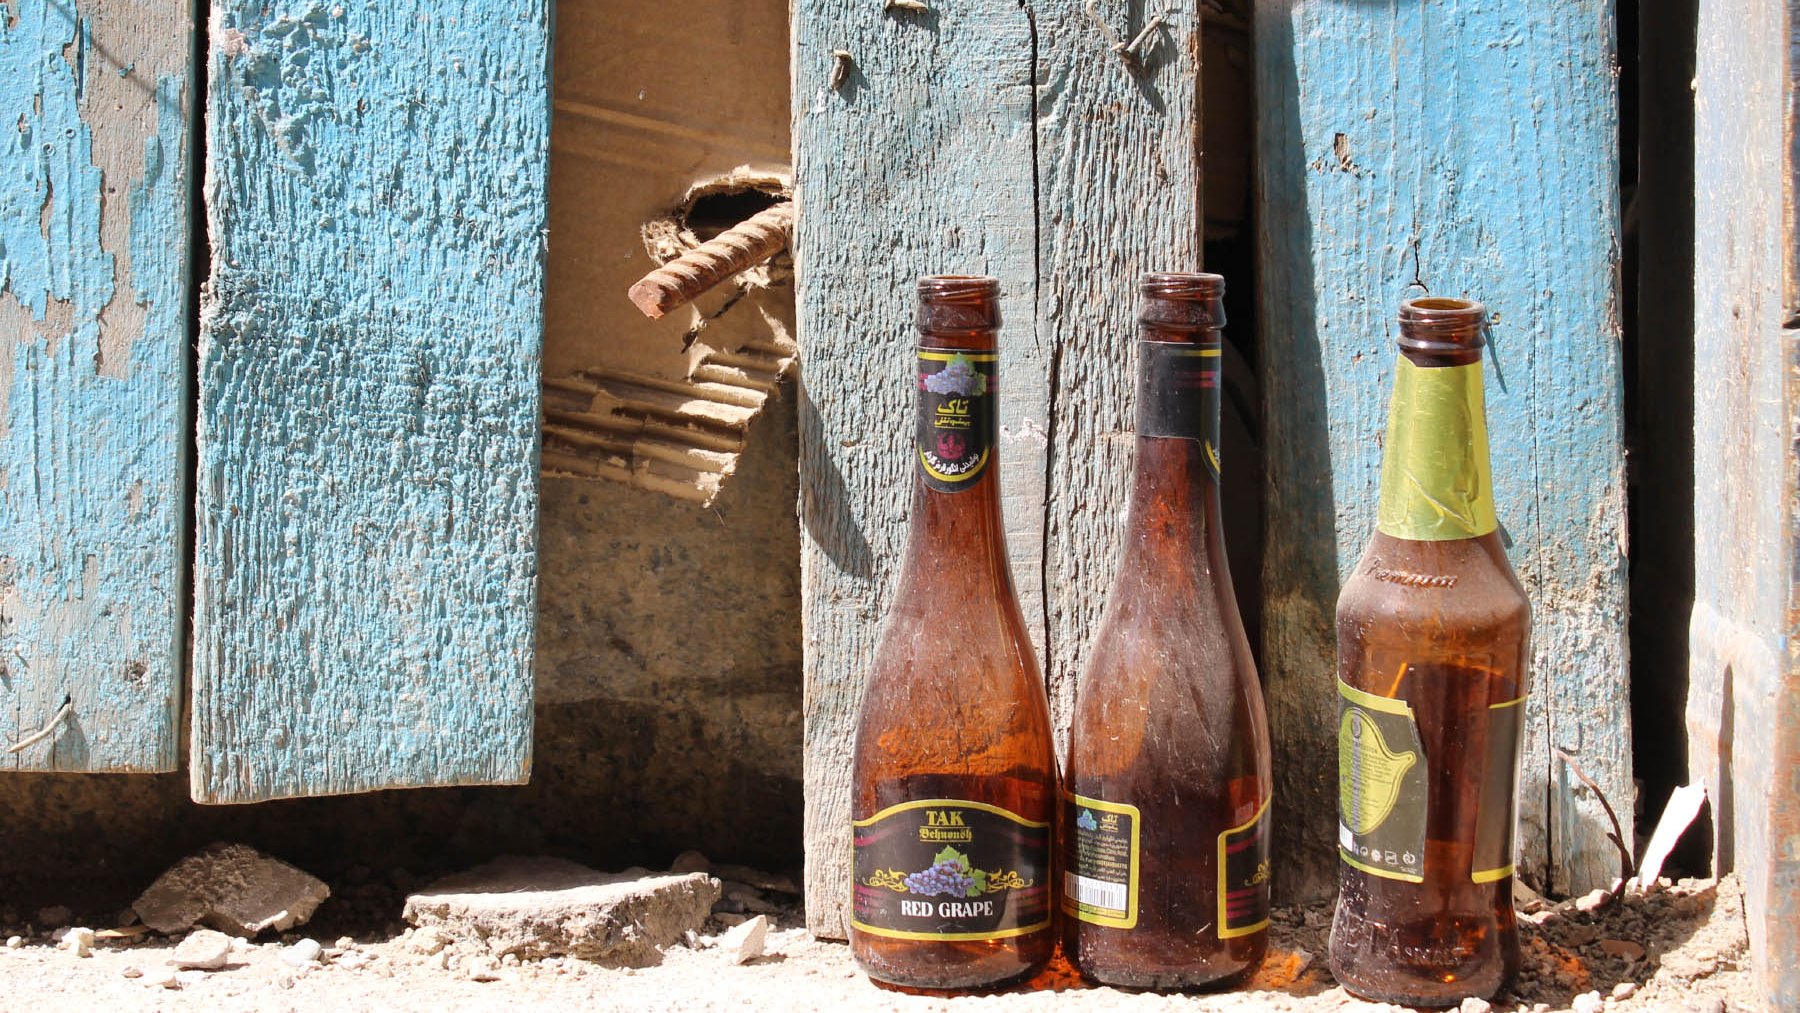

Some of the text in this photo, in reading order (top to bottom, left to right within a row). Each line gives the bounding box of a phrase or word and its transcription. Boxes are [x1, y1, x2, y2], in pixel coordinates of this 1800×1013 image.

[926, 810, 965, 826] TAK
[901, 900, 993, 918] RED GRAPE
